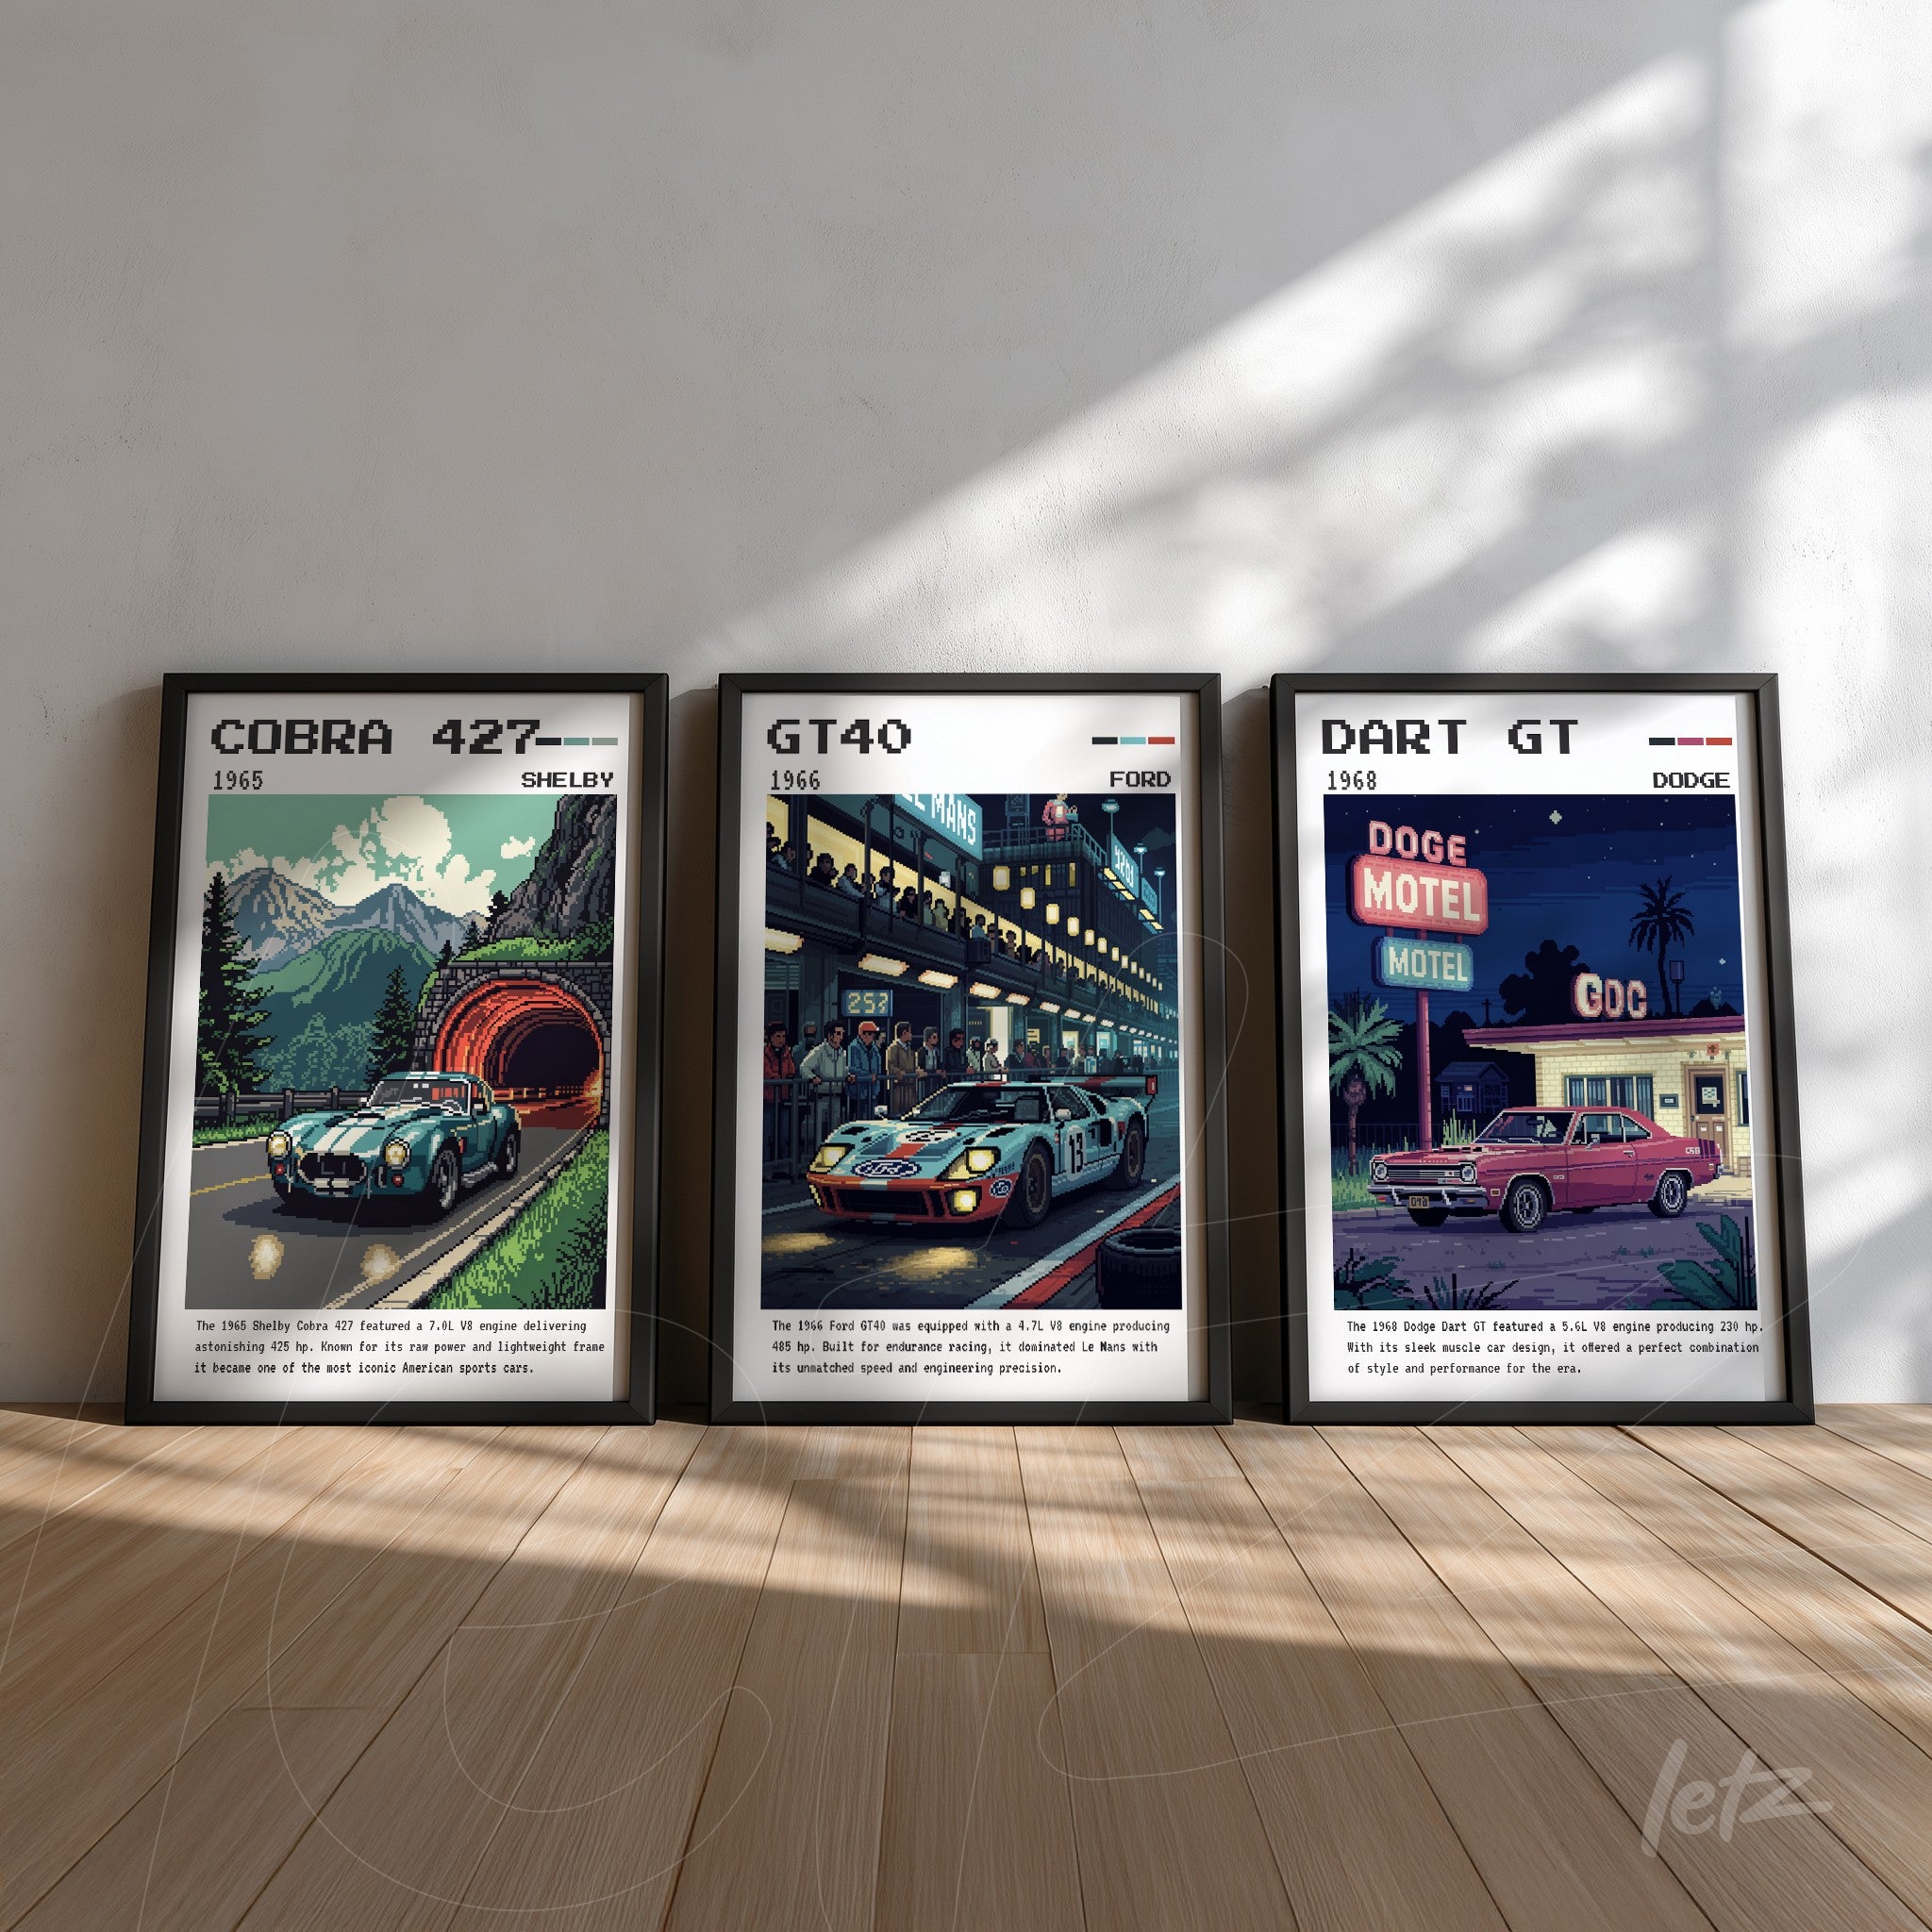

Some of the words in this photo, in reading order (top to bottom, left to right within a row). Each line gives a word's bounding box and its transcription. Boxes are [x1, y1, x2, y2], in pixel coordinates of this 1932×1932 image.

[211, 720, 391, 754] COBRA
[433, 720, 540, 754] 427
[767, 720, 910, 754] GT40
[1323, 720, 1466, 754] DART
[1508, 720, 1577, 754] GT
[214, 771, 262, 790] 1965
[522, 773, 613, 787] SHELBY
[772, 771, 820, 790] 1966
[1110, 772, 1171, 787] FORD
[1328, 771, 1375, 790] 1968
[1654, 773, 1730, 788] DODGE
[1369, 821, 1467, 866] DOGE
[1363, 868, 1480, 921] MOTEL
[1389, 947, 1468, 981] MOTEL
[1069, 1132, 1083, 1174] 13
[195, 1320, 216, 1331] The
[221, 1320, 247, 1331] 1965
[252, 1320, 291, 1334] Shelby
[296, 1320, 329, 1331] Cobra
[334, 1320, 354, 1332] 427
[359, 1320, 410, 1331] featured
[416, 1323, 424, 1331] a
[428, 1320, 455, 1331] 7.0L
[459, 1320, 474, 1331] V8
[478, 1320, 518, 1334] engine
[523, 1320, 587, 1334] delivering
[772, 1319, 791, 1332] The
[798, 1320, 824, 1332] 1966
[829, 1320, 855, 1332] Ford
[859, 1319, 886, 1332] GT40
[891, 1322, 911, 1332] was
[917, 1320, 969, 1335] equipped
[974, 1320, 1000, 1332] with
[1005, 1322, 1012, 1332] a
[1018, 1319, 1044, 1332] 4.7L
[1049, 1320, 1063, 1332] V8
[1068, 1320, 1108, 1334] engine
[1112, 1320, 1171, 1335] producing
[1346, 1321, 1367, 1332] The
[1373, 1321, 1398, 1332] 1968
[1403, 1321, 1436, 1335] Dodge
[1441, 1321, 1467, 1332] Dart
[1473, 1321, 1487, 1332] GT
[1492, 1321, 1543, 1332] featured
[1549, 1323, 1557, 1332] a
[1561, 1321, 1588, 1332] 5.6L
[1592, 1321, 1607, 1332] V8
[1612, 1321, 1651, 1335] engine
[1656, 1321, 1714, 1335] producing
[1720, 1321, 1739, 1332] 230
[1744, 1321, 1763, 1335] hp.
[194, 1341, 265, 1355] astonishing
[270, 1341, 290, 1352] 425
[295, 1341, 313, 1355] hp.
[321, 1341, 353, 1352] Known
[358, 1341, 378, 1352] for
[384, 1341, 403, 1352] its
[408, 1343, 429, 1352] raw
[434, 1343, 467, 1355] power
[472, 1341, 492, 1352] and
[497, 1341, 567, 1355] lightweight
[573, 1341, 606, 1352] frame
[772, 1341, 791, 1352] 485
[797, 1341, 815, 1355] hp.
[822, 1340, 855, 1352] Built
[860, 1341, 880, 1353] for
[885, 1341, 943, 1353] endurance
[948, 1341, 991, 1356] racing,
[999, 1341, 1012, 1353] it
[1018, 1341, 1075, 1353] dominated
[1081, 1341, 1094, 1353] Le
[1131, 1341, 1158, 1353] with
[1346, 1341, 1374, 1353] With
[1379, 1341, 1399, 1353] its
[1405, 1341, 1437, 1353] sleek
[1441, 1341, 1481, 1353] muscle
[1486, 1343, 1507, 1353] car
[1511, 1341, 1556, 1356] design,
[1563, 1341, 1575, 1353] it
[1581, 1341, 1621, 1353] offered
[1625, 1343, 1633, 1353] a
[1638, 1341, 1683, 1356] perfect
[1689, 1341, 1759, 1353] combination
[194, 1361, 207, 1374] it
[211, 1361, 252, 1374] became
[257, 1364, 276, 1374] one
[282, 1361, 295, 1374] of
[301, 1361, 321, 1374] the
[325, 1361, 352, 1374] most
[358, 1361, 396, 1374] iconic
[402, 1361, 454, 1374] American
[458, 1361, 497, 1376] sports
[502, 1364, 534, 1374] cars.
[772, 1361, 791, 1374] its
[796, 1361, 855, 1374] unmatched
[860, 1361, 893, 1376] speed
[897, 1361, 918, 1374] and
[923, 1361, 993, 1376] engineering
[999, 1361, 1061, 1376] precision.
[1347, 1362, 1360, 1374] of
[1367, 1362, 1399, 1376] style
[1405, 1362, 1424, 1374] and
[1429, 1362, 1501, 1376] performance
[1507, 1362, 1525, 1374] for
[1531, 1362, 1552, 1374] the
[1557, 1365, 1581, 1374] era.
